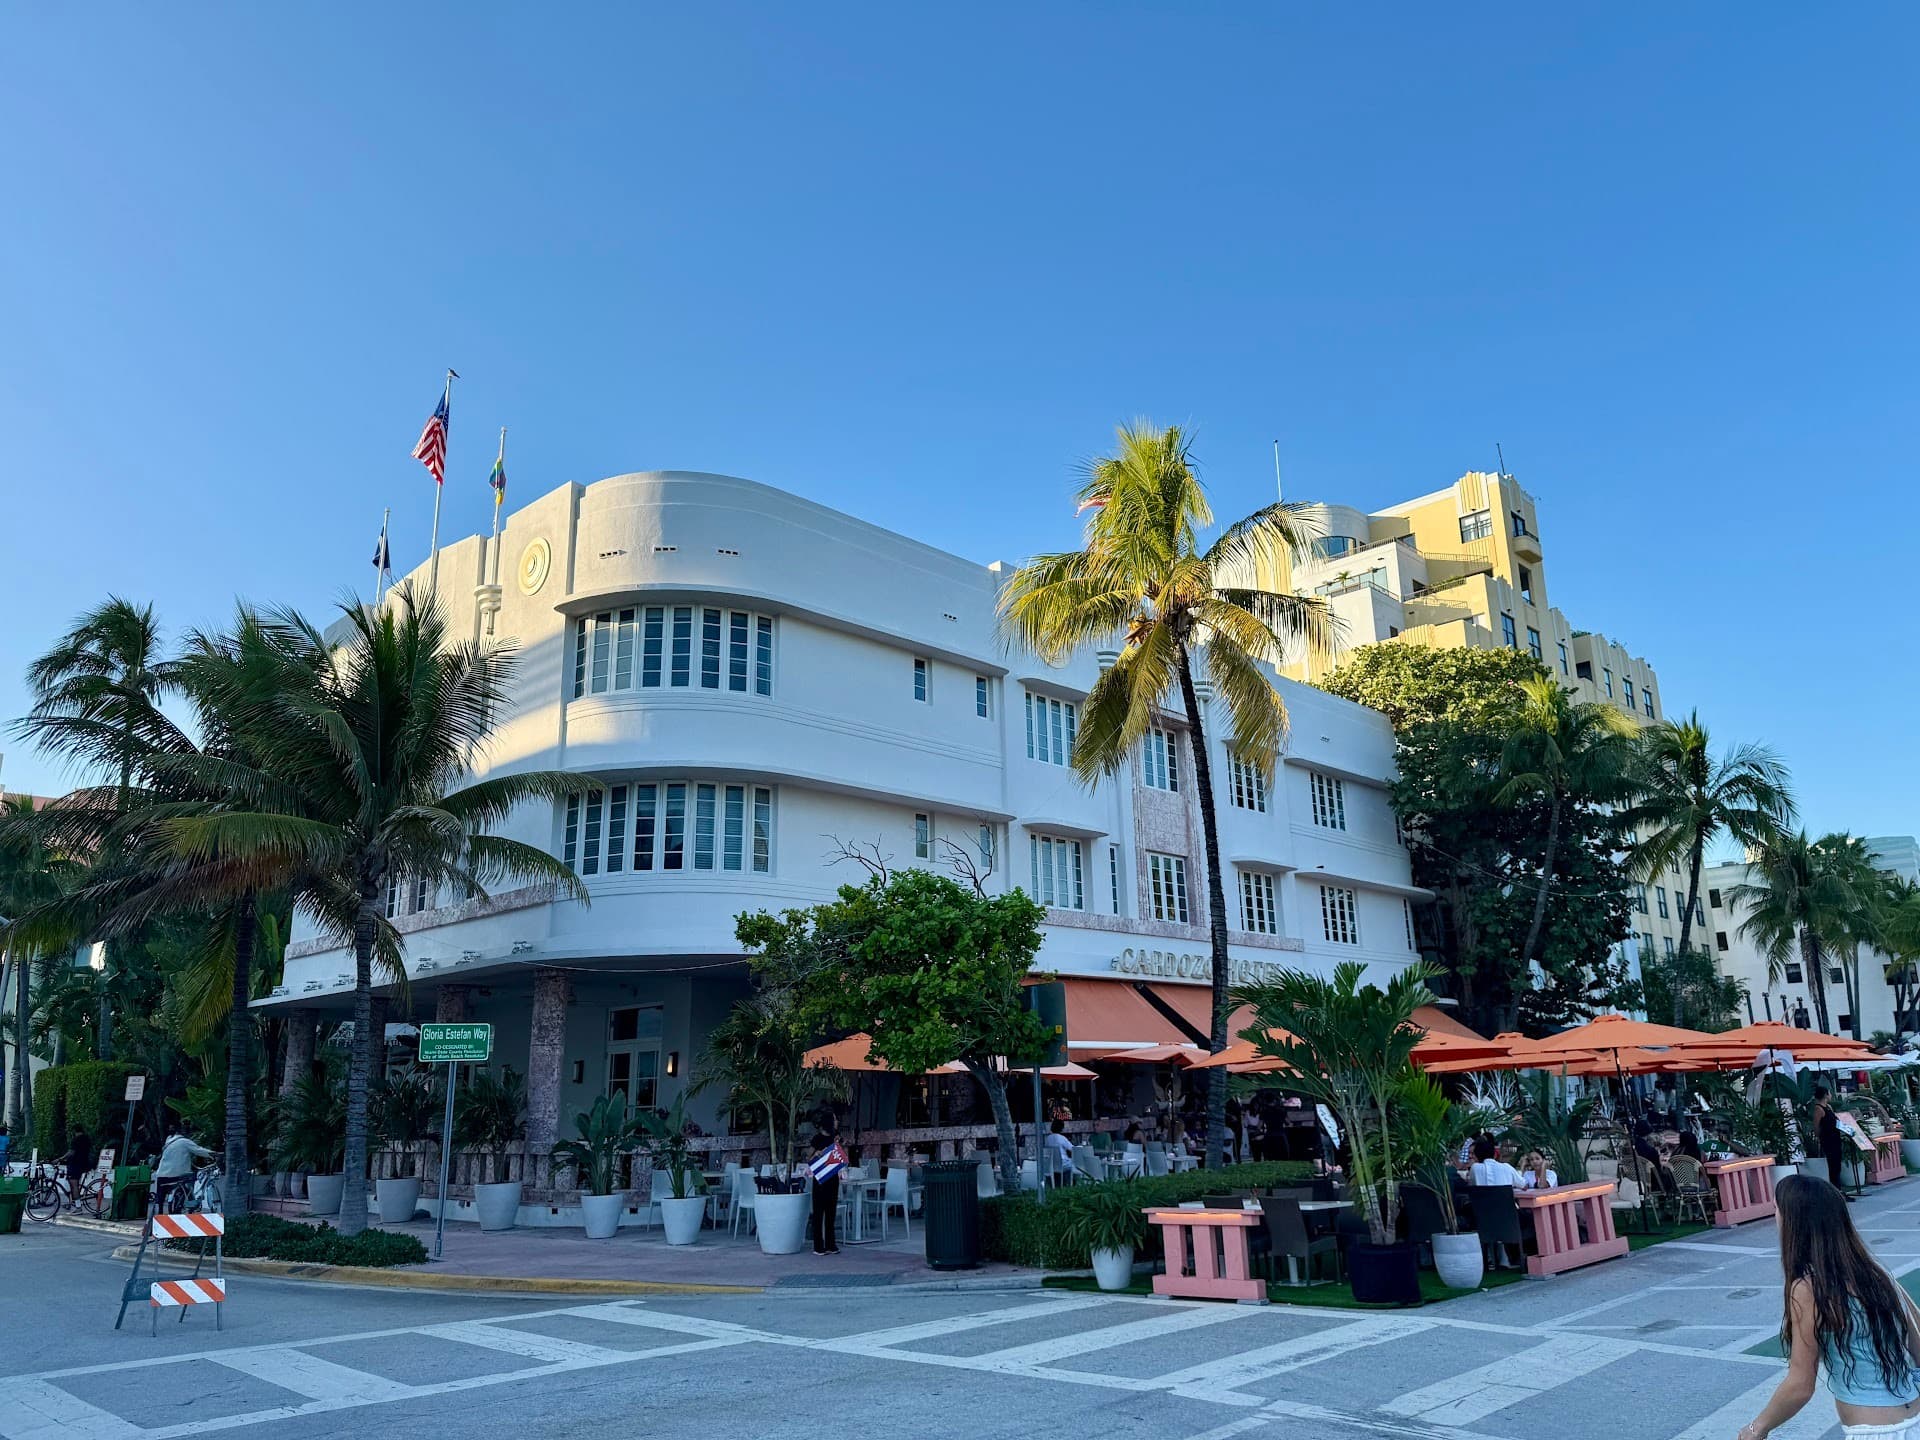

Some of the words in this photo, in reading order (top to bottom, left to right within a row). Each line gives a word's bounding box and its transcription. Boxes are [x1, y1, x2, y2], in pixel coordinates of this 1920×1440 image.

[1120, 947, 1214, 980] CARDOZO
[424, 1028, 444, 1040] Gloria
[446, 1028, 471, 1040] Estefan
[474, 1028, 488, 1042] Way
